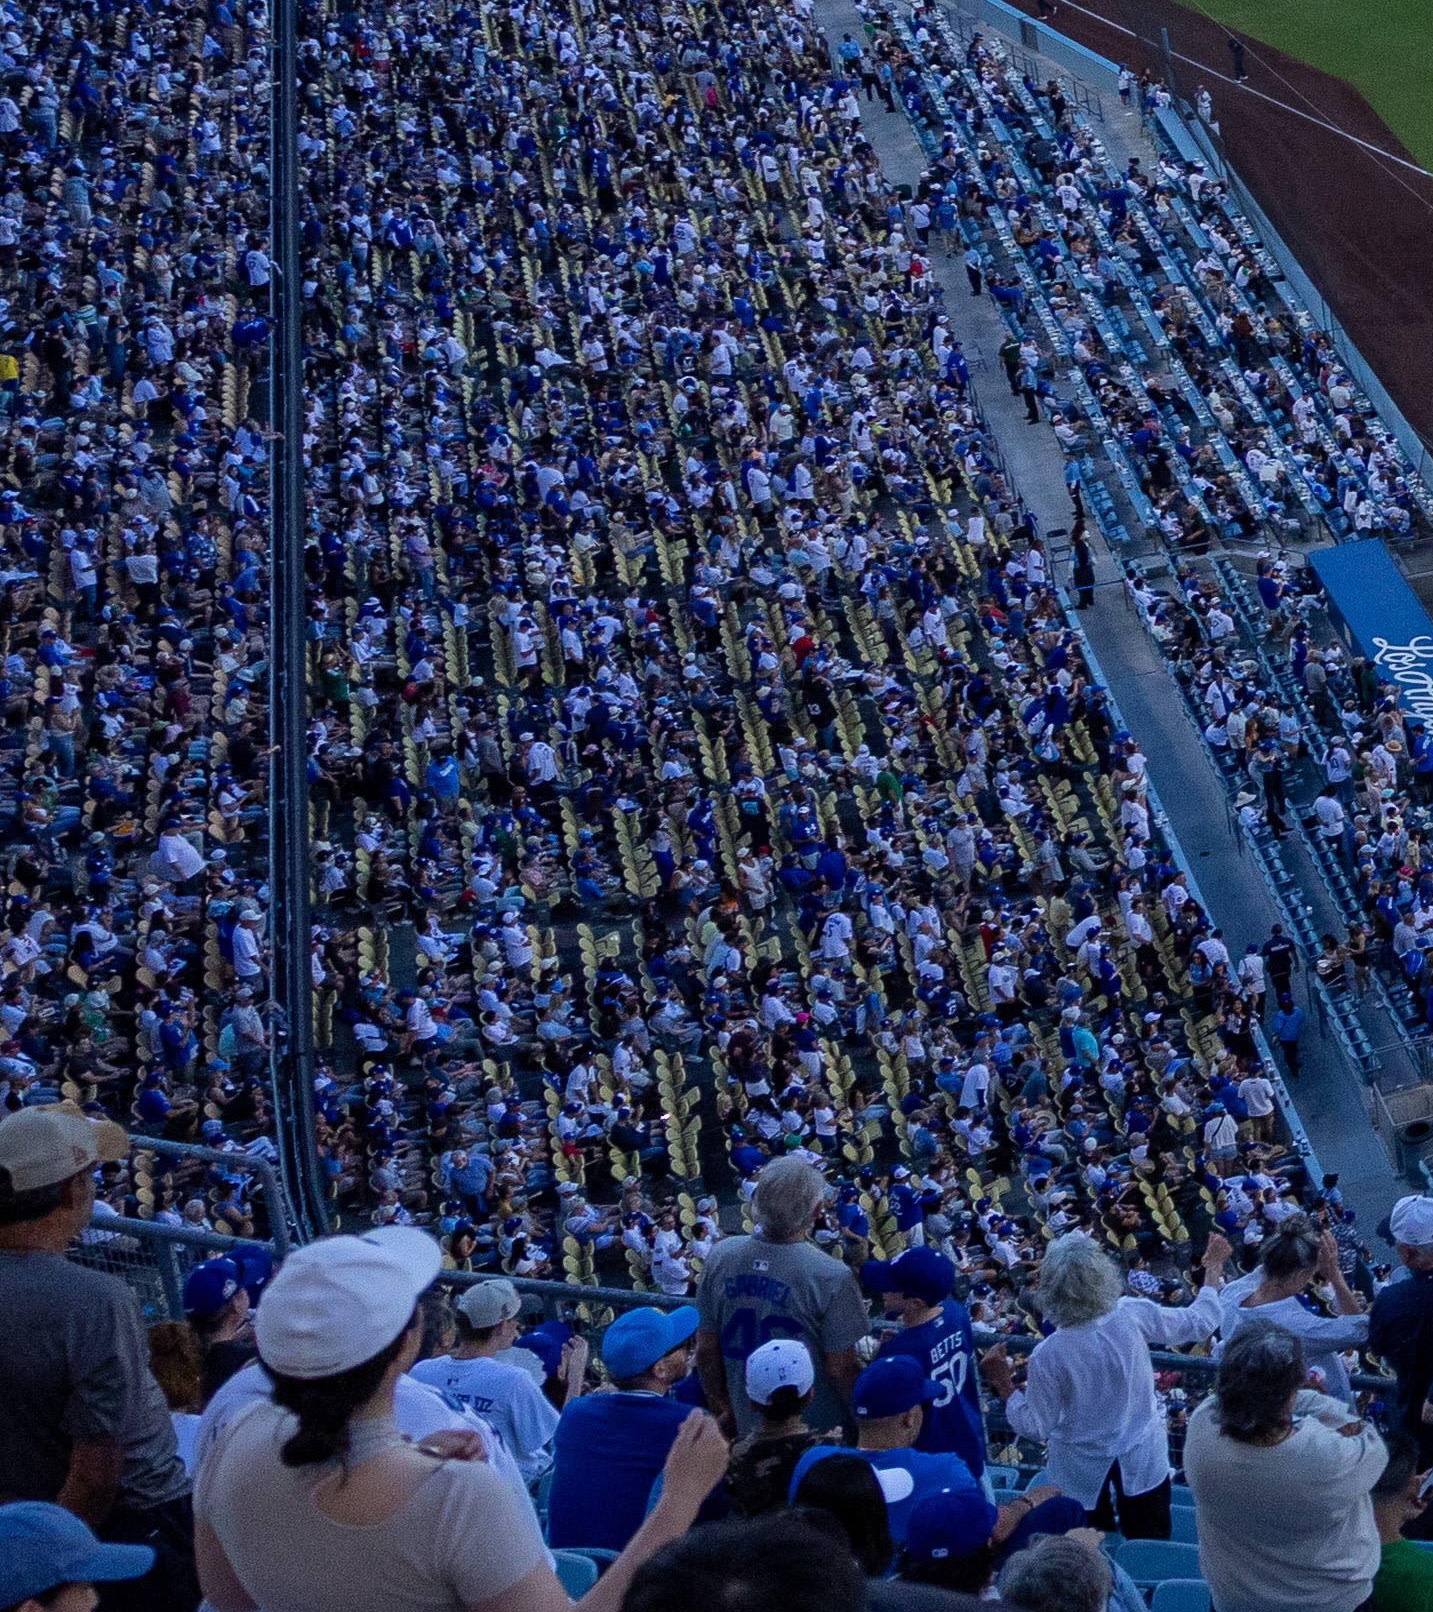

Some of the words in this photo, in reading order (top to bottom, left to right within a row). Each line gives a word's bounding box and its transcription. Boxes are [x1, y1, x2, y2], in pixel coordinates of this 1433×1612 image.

[724, 1274, 791, 1309] GABRIEL
[930, 1330, 963, 1365] BETTS
[931, 1350, 968, 1409] 50
